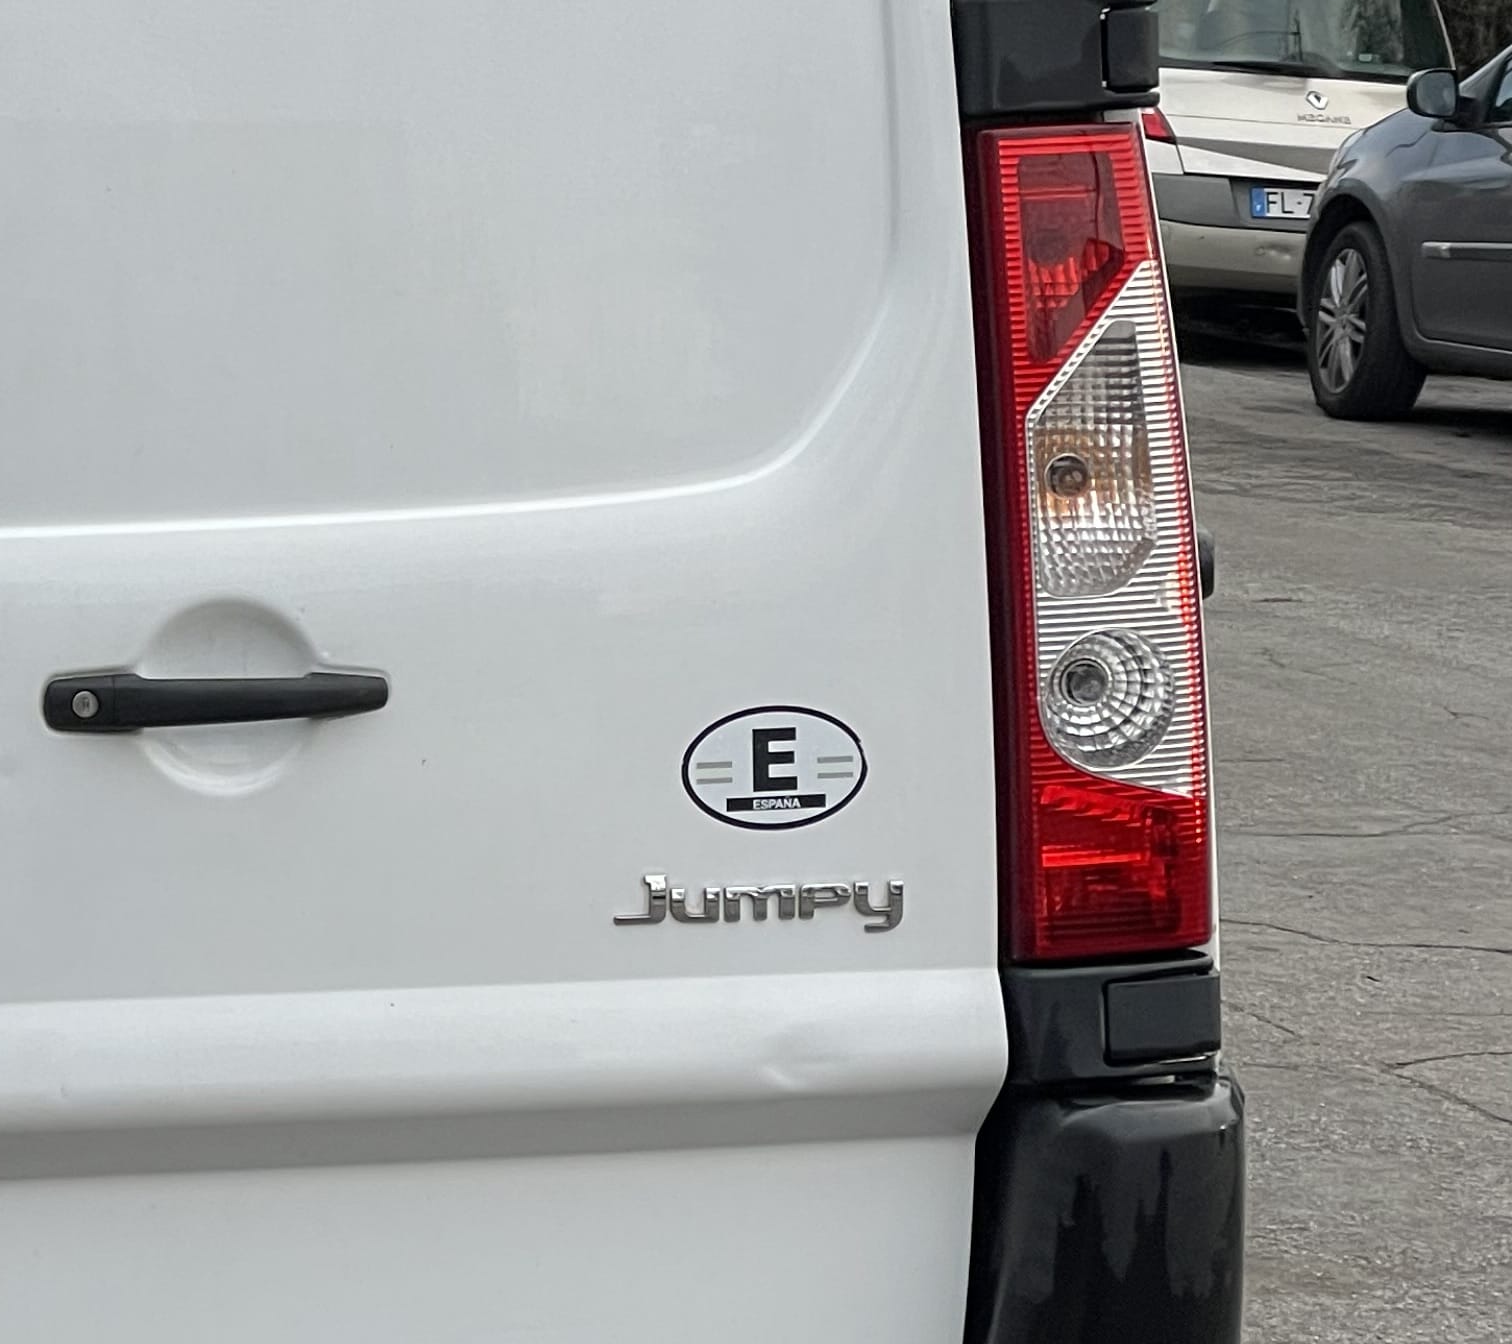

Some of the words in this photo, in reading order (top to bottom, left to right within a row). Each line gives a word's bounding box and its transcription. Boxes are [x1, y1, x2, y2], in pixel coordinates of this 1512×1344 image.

[752, 727, 798, 792] E
[753, 795, 801, 810] ESPAÑA
[613, 874, 904, 933] Jumpy
